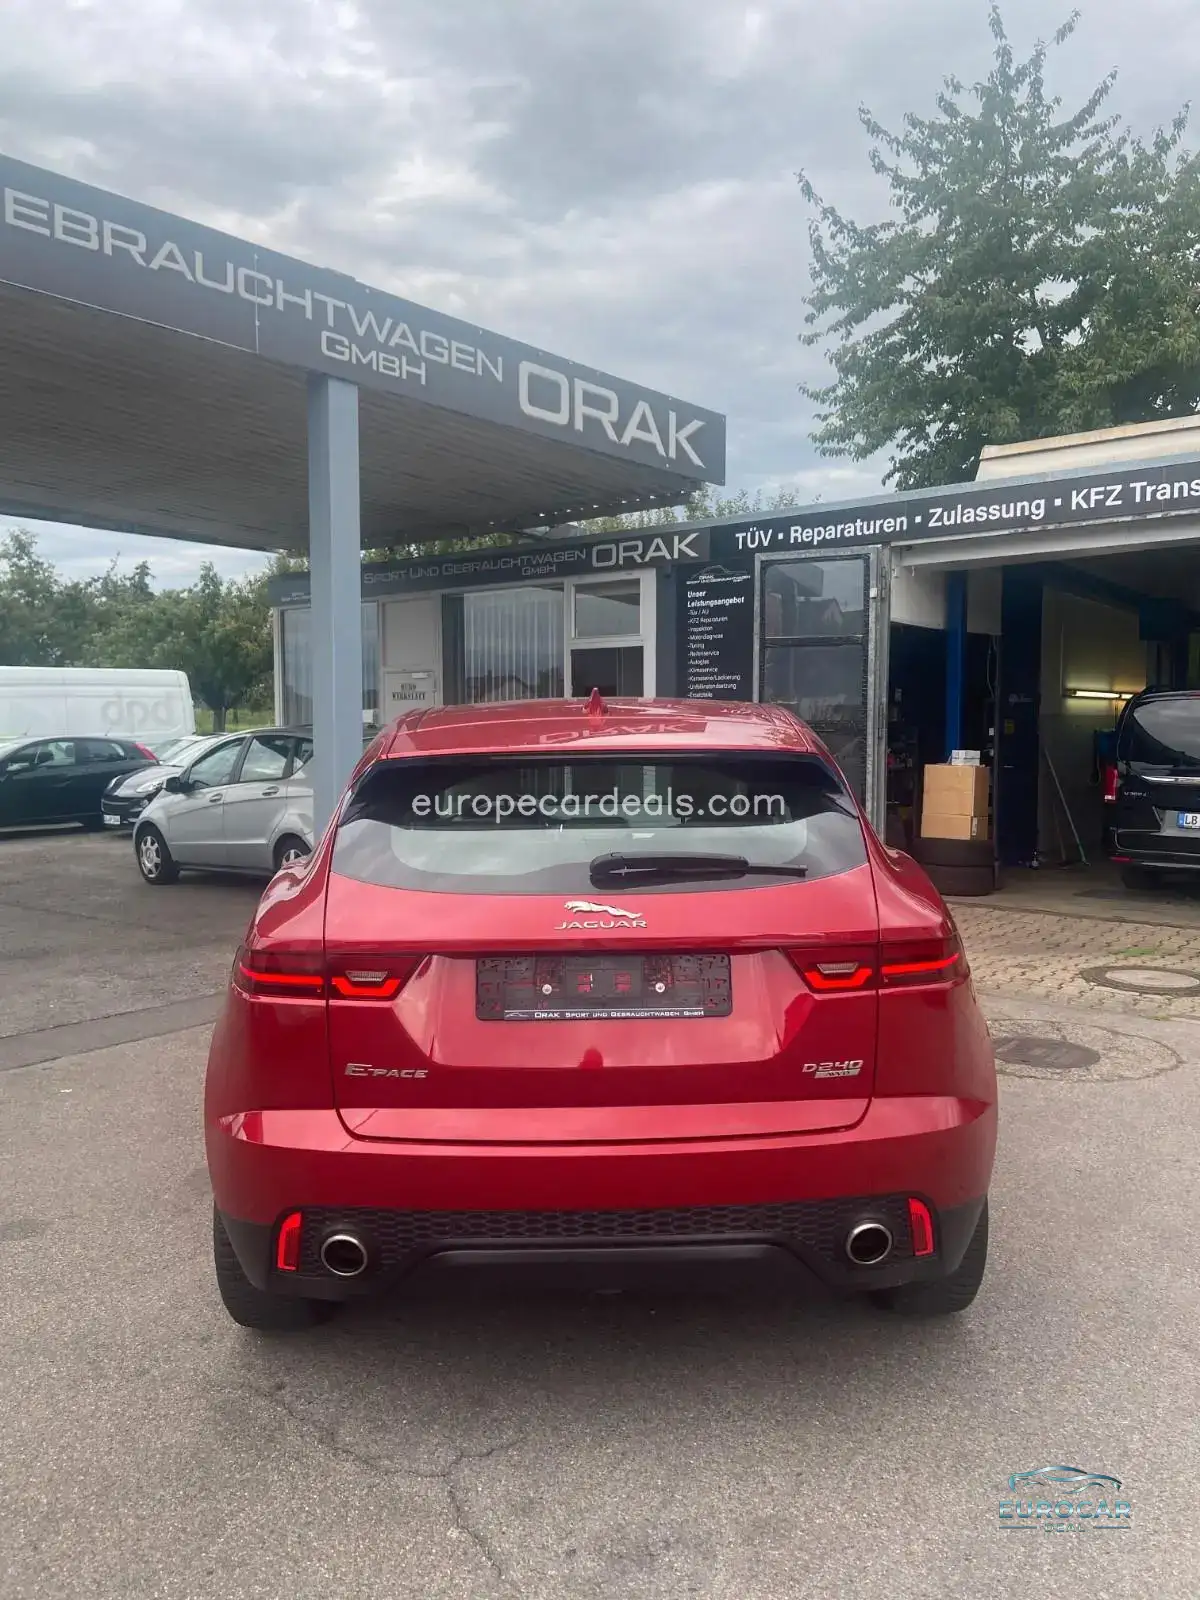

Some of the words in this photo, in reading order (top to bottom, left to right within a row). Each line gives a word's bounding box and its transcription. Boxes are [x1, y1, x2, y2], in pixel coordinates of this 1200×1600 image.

[4, 187, 503, 382] EBRAUCHTWAGEN
[519, 360, 706, 469] ORAK
[735, 526, 773, 549] TÜV
[790, 513, 907, 546] Reparaturen
[928, 498, 1045, 529] Zulassung
[1071, 484, 1122, 510] KFZ
[1129, 478, 1200, 503] Trans
[592, 532, 700, 568] ORAK
[687, 596, 745, 607] Leistungsangebot
[101, 691, 175, 734] dpd
[1185, 815, 1198, 825] LB
[554, 919, 648, 930] JAGUAR
[802, 1060, 864, 1073] D240
